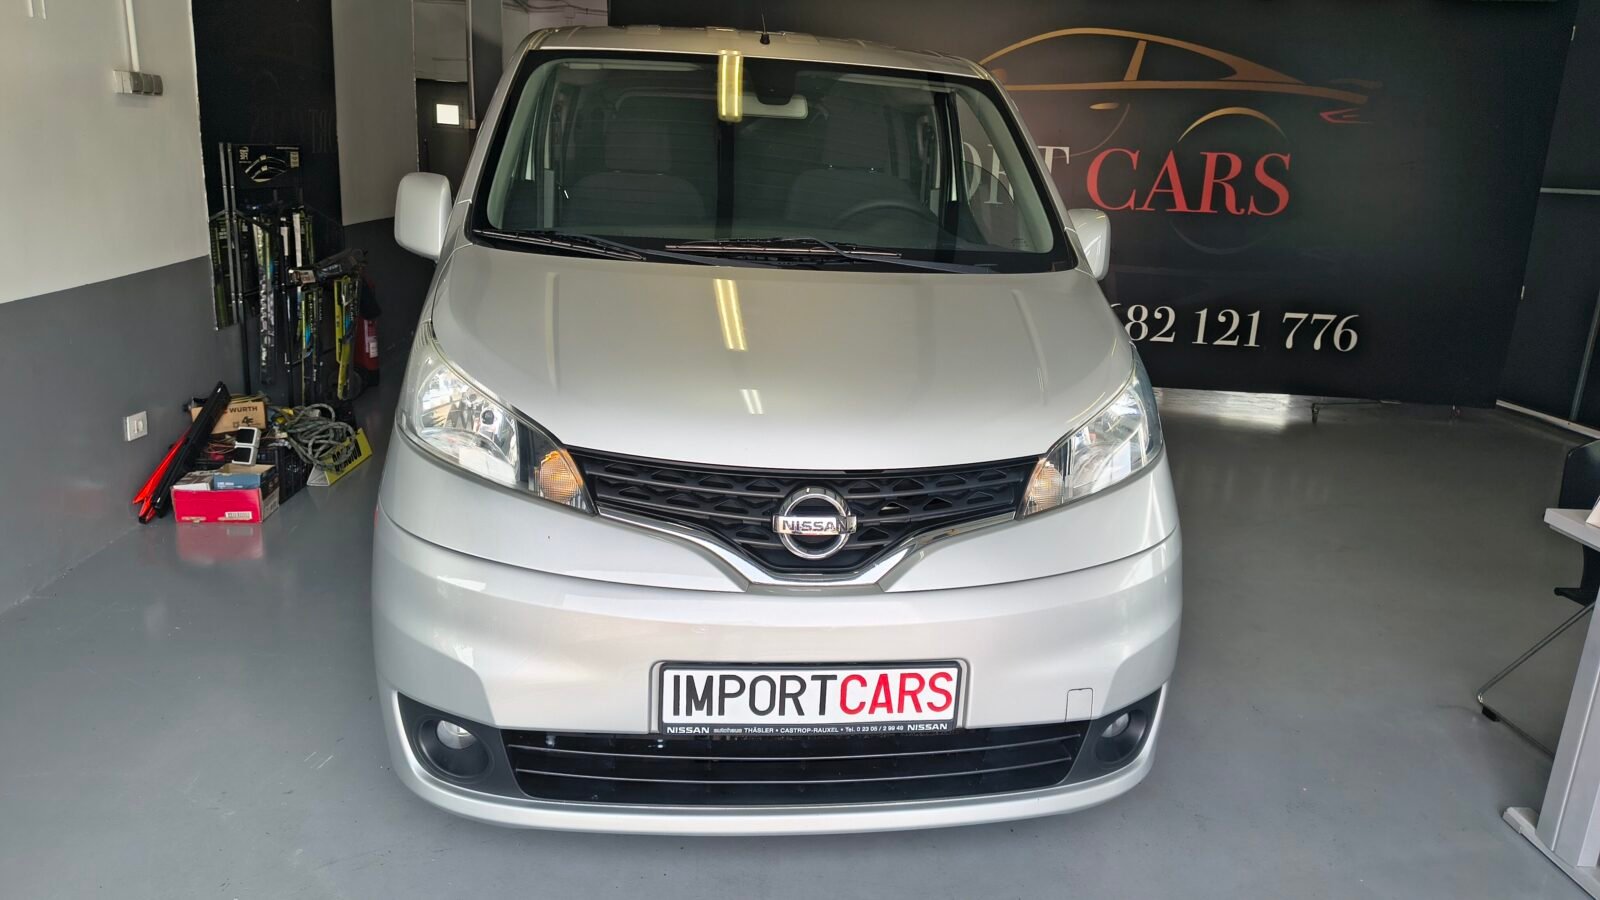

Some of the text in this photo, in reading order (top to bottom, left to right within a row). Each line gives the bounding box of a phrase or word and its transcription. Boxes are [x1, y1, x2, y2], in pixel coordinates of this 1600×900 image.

[1086, 148, 1291, 216] CARS
[1110, 303, 1359, 352] 82 121 776
[782, 516, 847, 533] NISSAN
[666, 726, 710, 734] NISSAN
[907, 723, 948, 731] NISSAN
